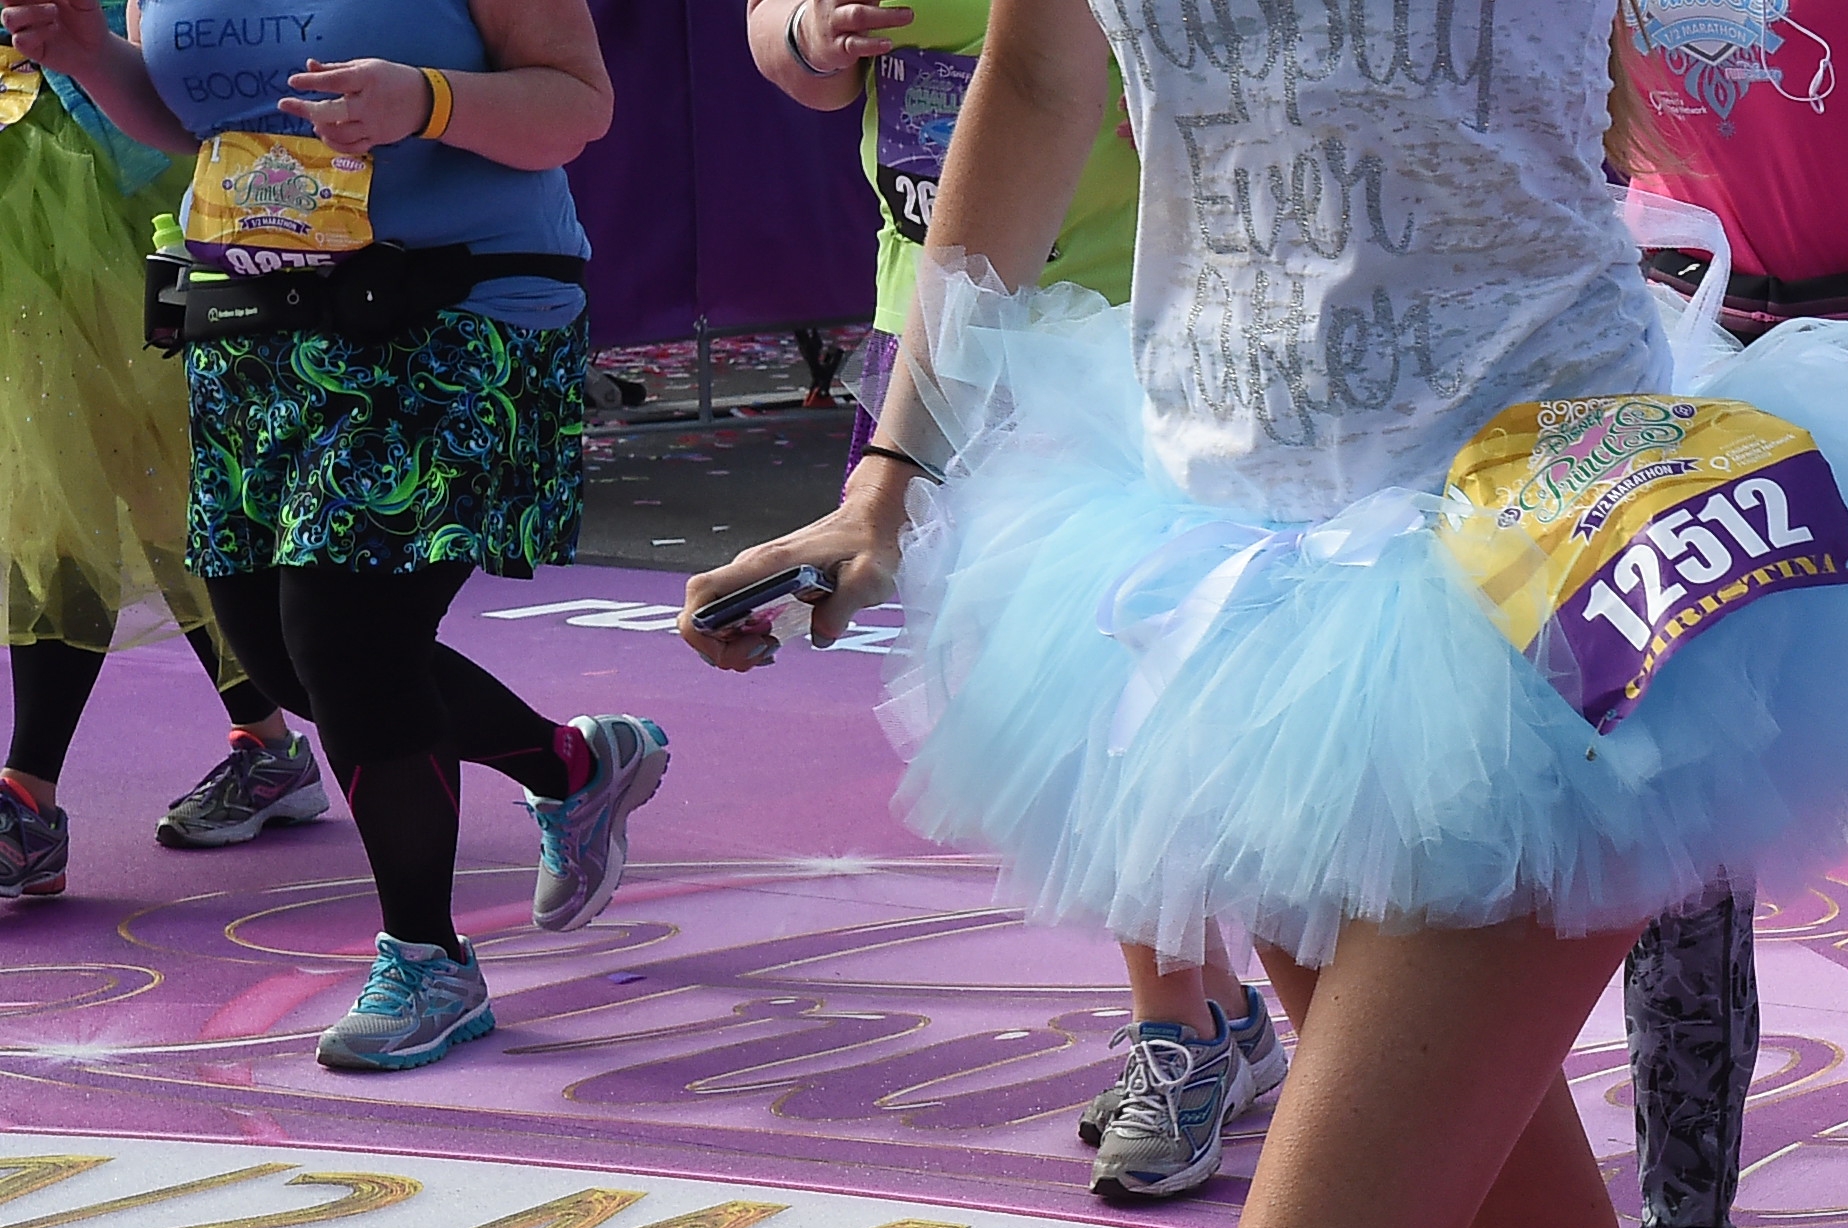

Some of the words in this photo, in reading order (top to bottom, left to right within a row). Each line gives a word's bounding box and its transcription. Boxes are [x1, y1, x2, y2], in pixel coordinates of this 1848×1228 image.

[174, 13, 323, 50] BEAUTY.
[1682, 23, 1747, 43] MARATHON
[1174, 111, 1414, 260] Ever
[262, 217, 297, 231] MARATHON
[1610, 464, 1674, 503] MARATHON
[1581, 477, 1814, 652] 12512
[1625, 553, 1838, 700] CHRISTINA
